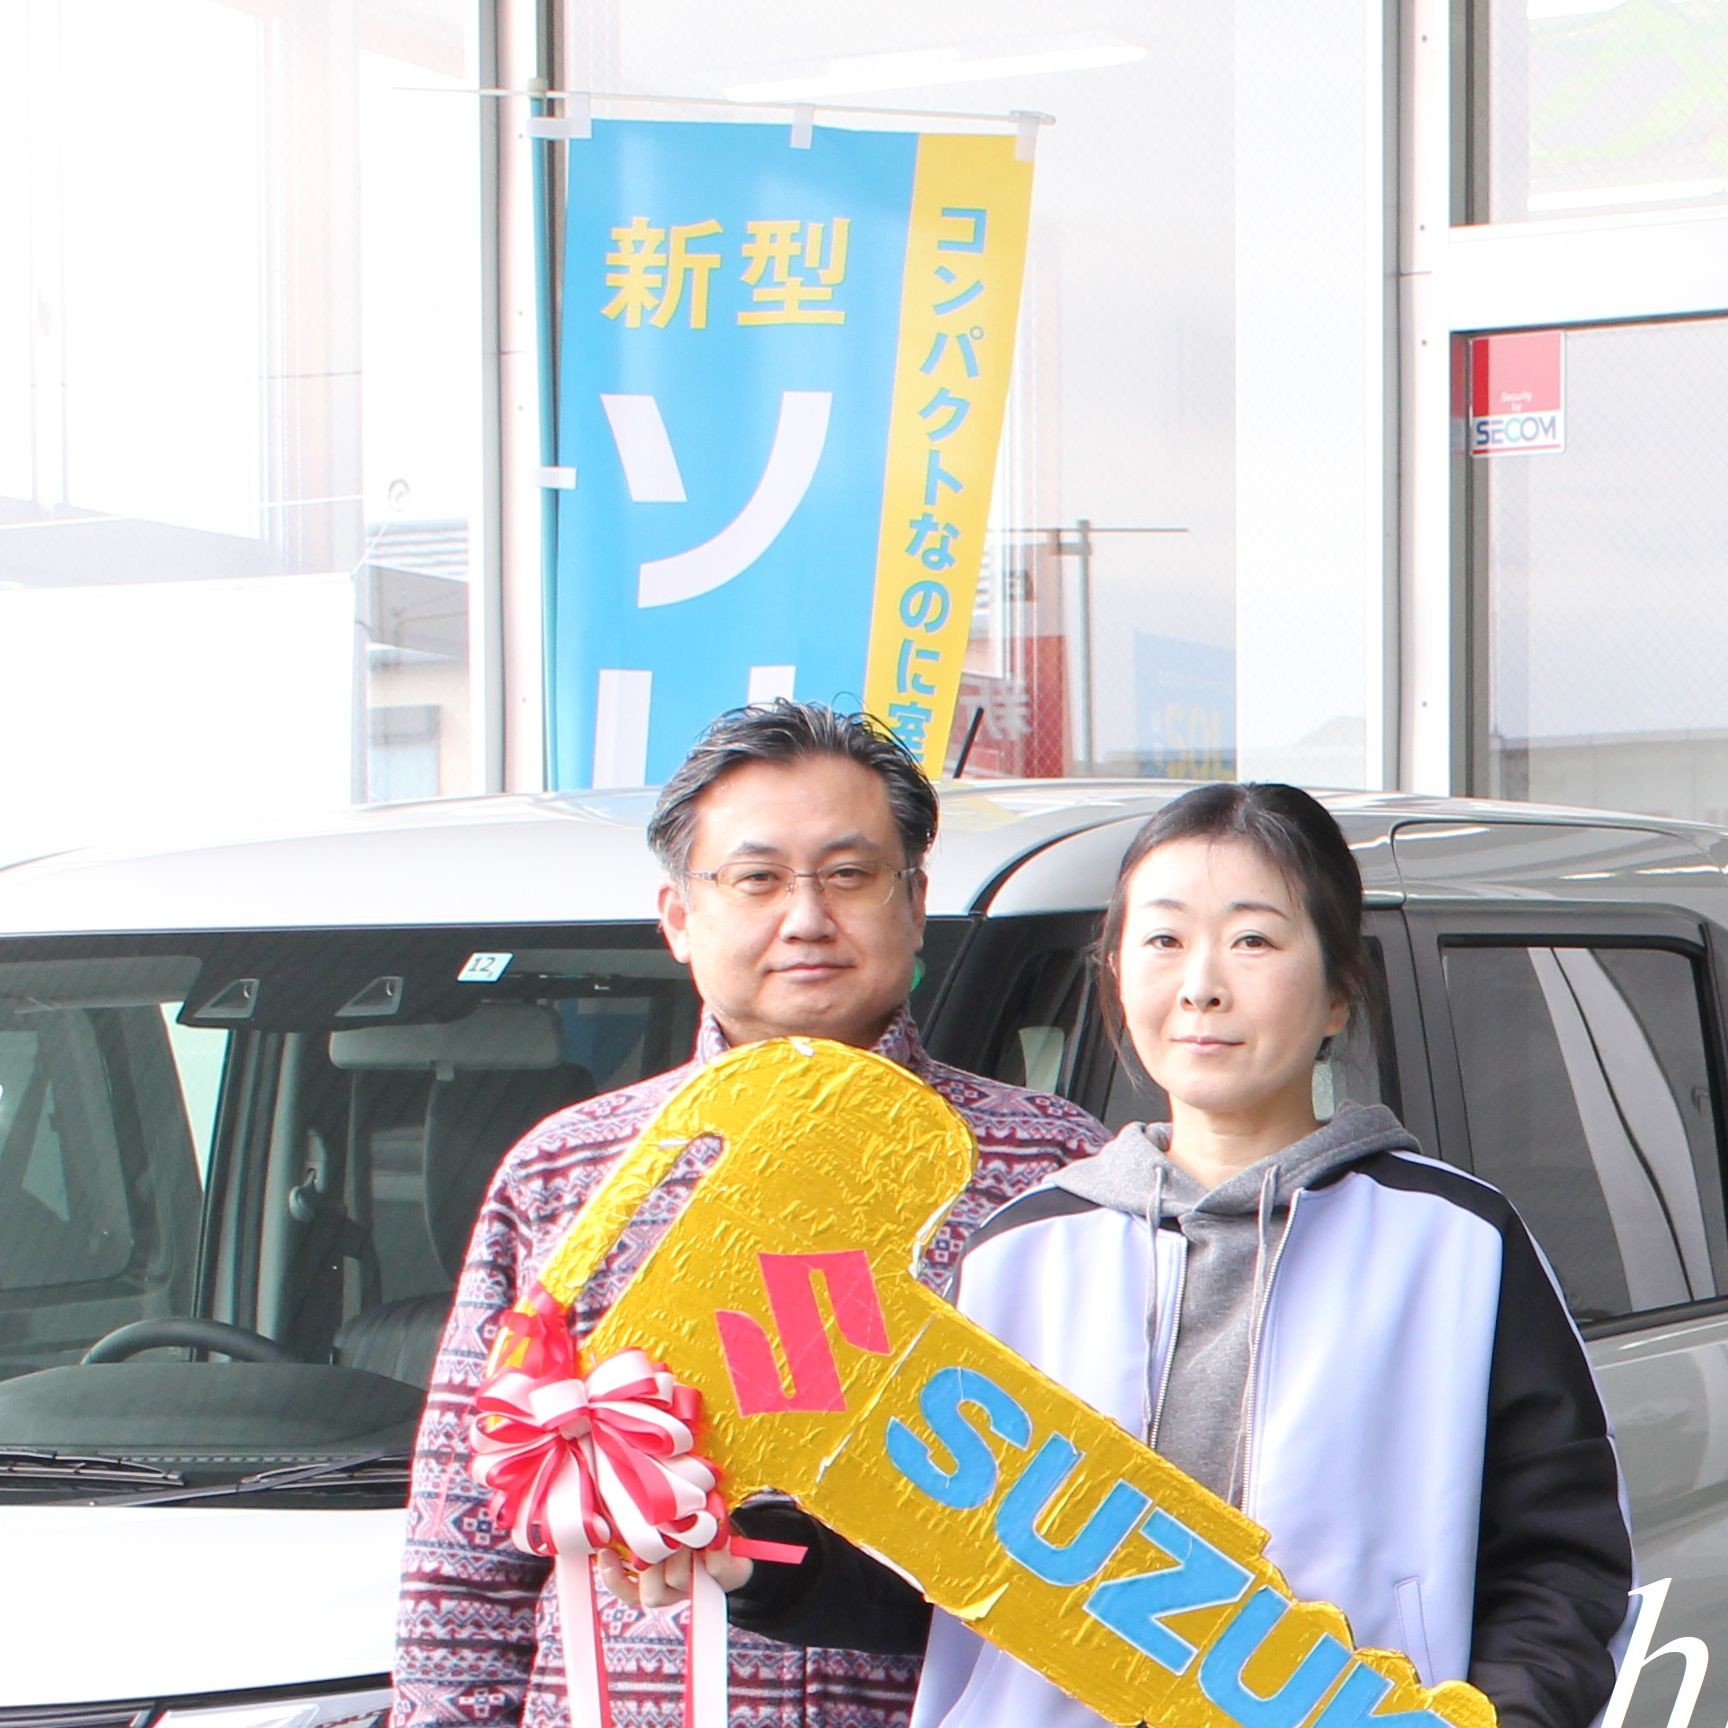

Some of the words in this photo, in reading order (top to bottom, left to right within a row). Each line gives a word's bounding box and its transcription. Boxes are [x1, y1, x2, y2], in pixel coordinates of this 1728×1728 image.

[600, 216, 851, 329] 新型
[1476, 416, 1557, 446] SECOM
[467, 956, 496, 972] 12
